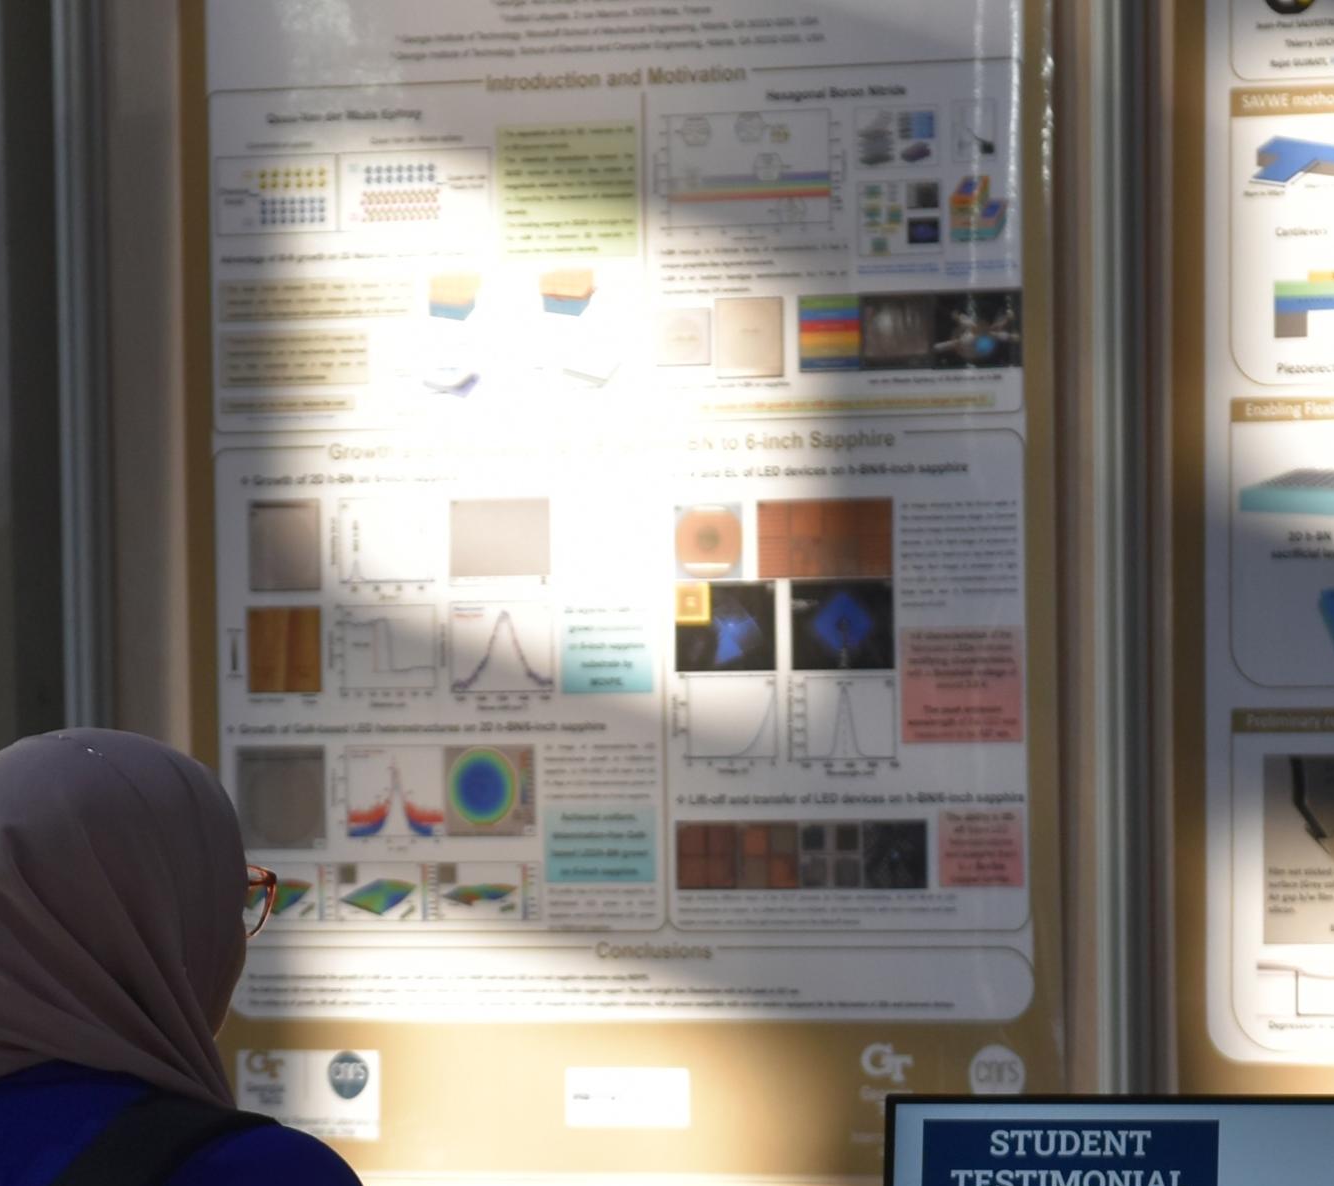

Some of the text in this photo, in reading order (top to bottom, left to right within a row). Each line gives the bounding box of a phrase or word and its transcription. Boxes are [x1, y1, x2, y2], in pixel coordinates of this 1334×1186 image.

[485, 70, 601, 93] Introduction
[647, 65, 747, 86] Motivation
[744, 431, 804, 451] 6-inch
[808, 429, 895, 453] Sapphire
[595, 940, 714, 961] Conclusions
[989, 1129, 1151, 1156] STUDENT
